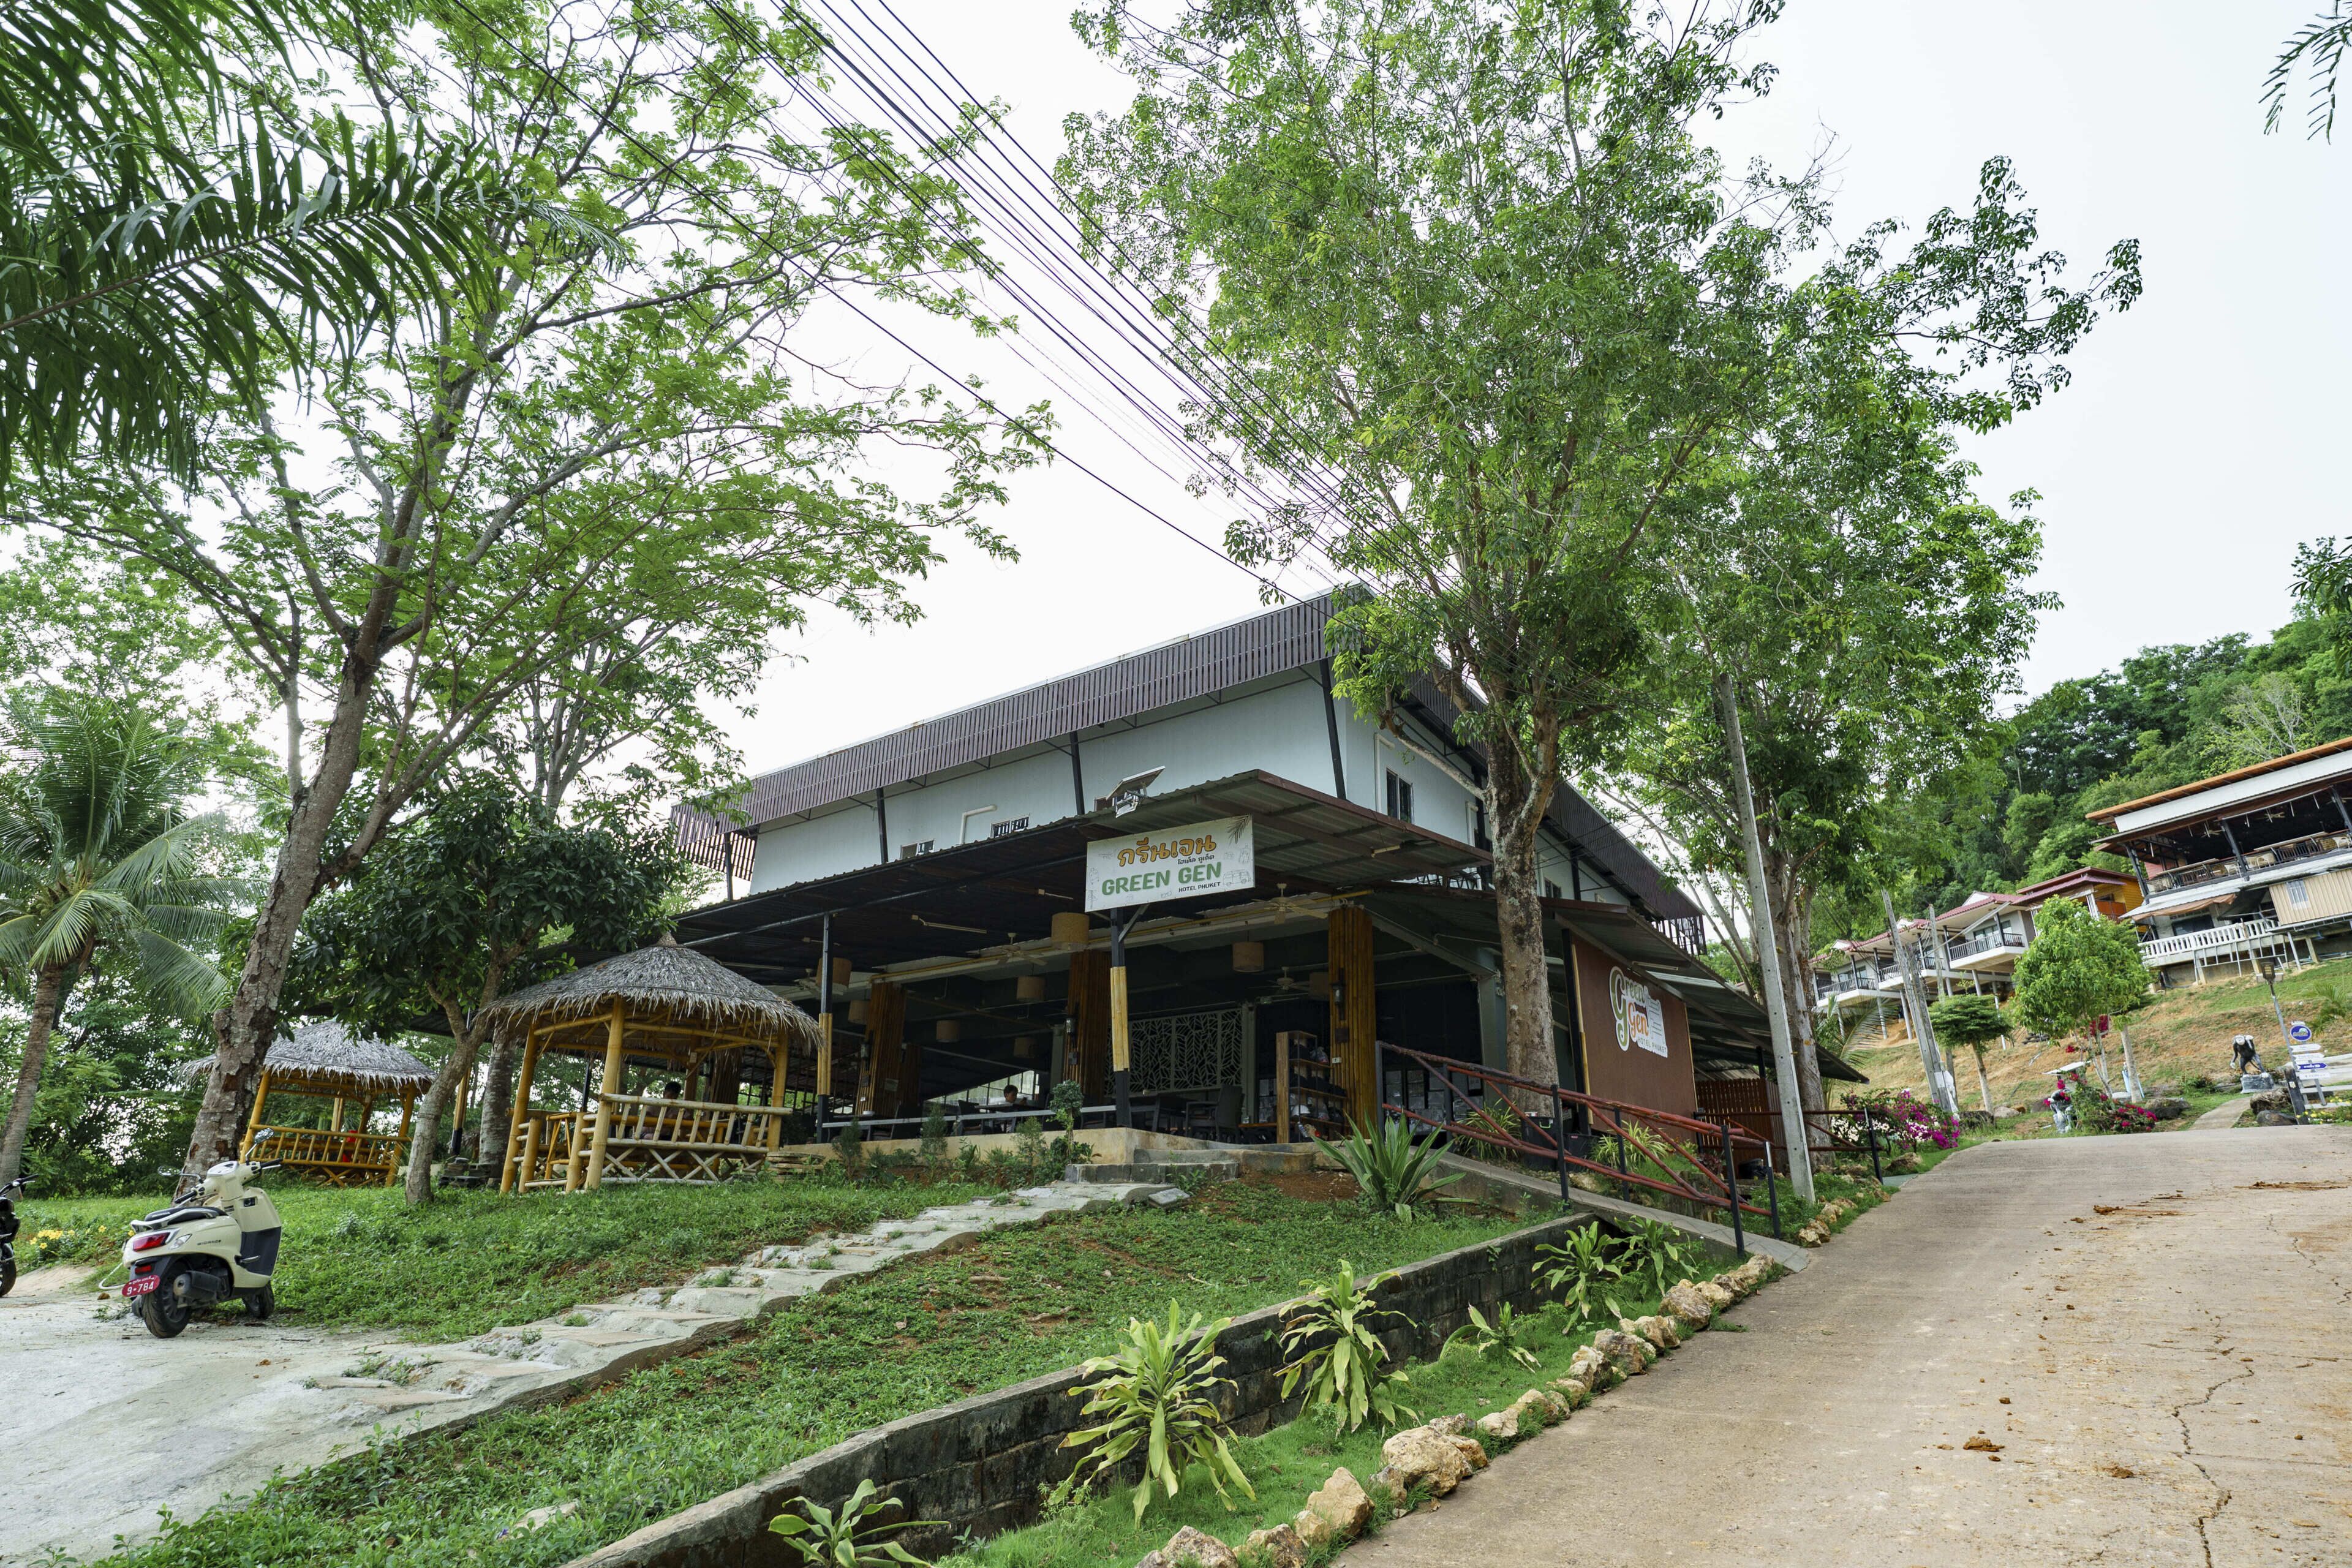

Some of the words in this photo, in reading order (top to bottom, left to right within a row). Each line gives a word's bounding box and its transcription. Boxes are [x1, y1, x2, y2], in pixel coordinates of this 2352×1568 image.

[1117, 835, 1216, 867] กรีนเจน
[1102, 870, 1171, 895] GREEN
[1178, 862, 1221, 884] GEN
